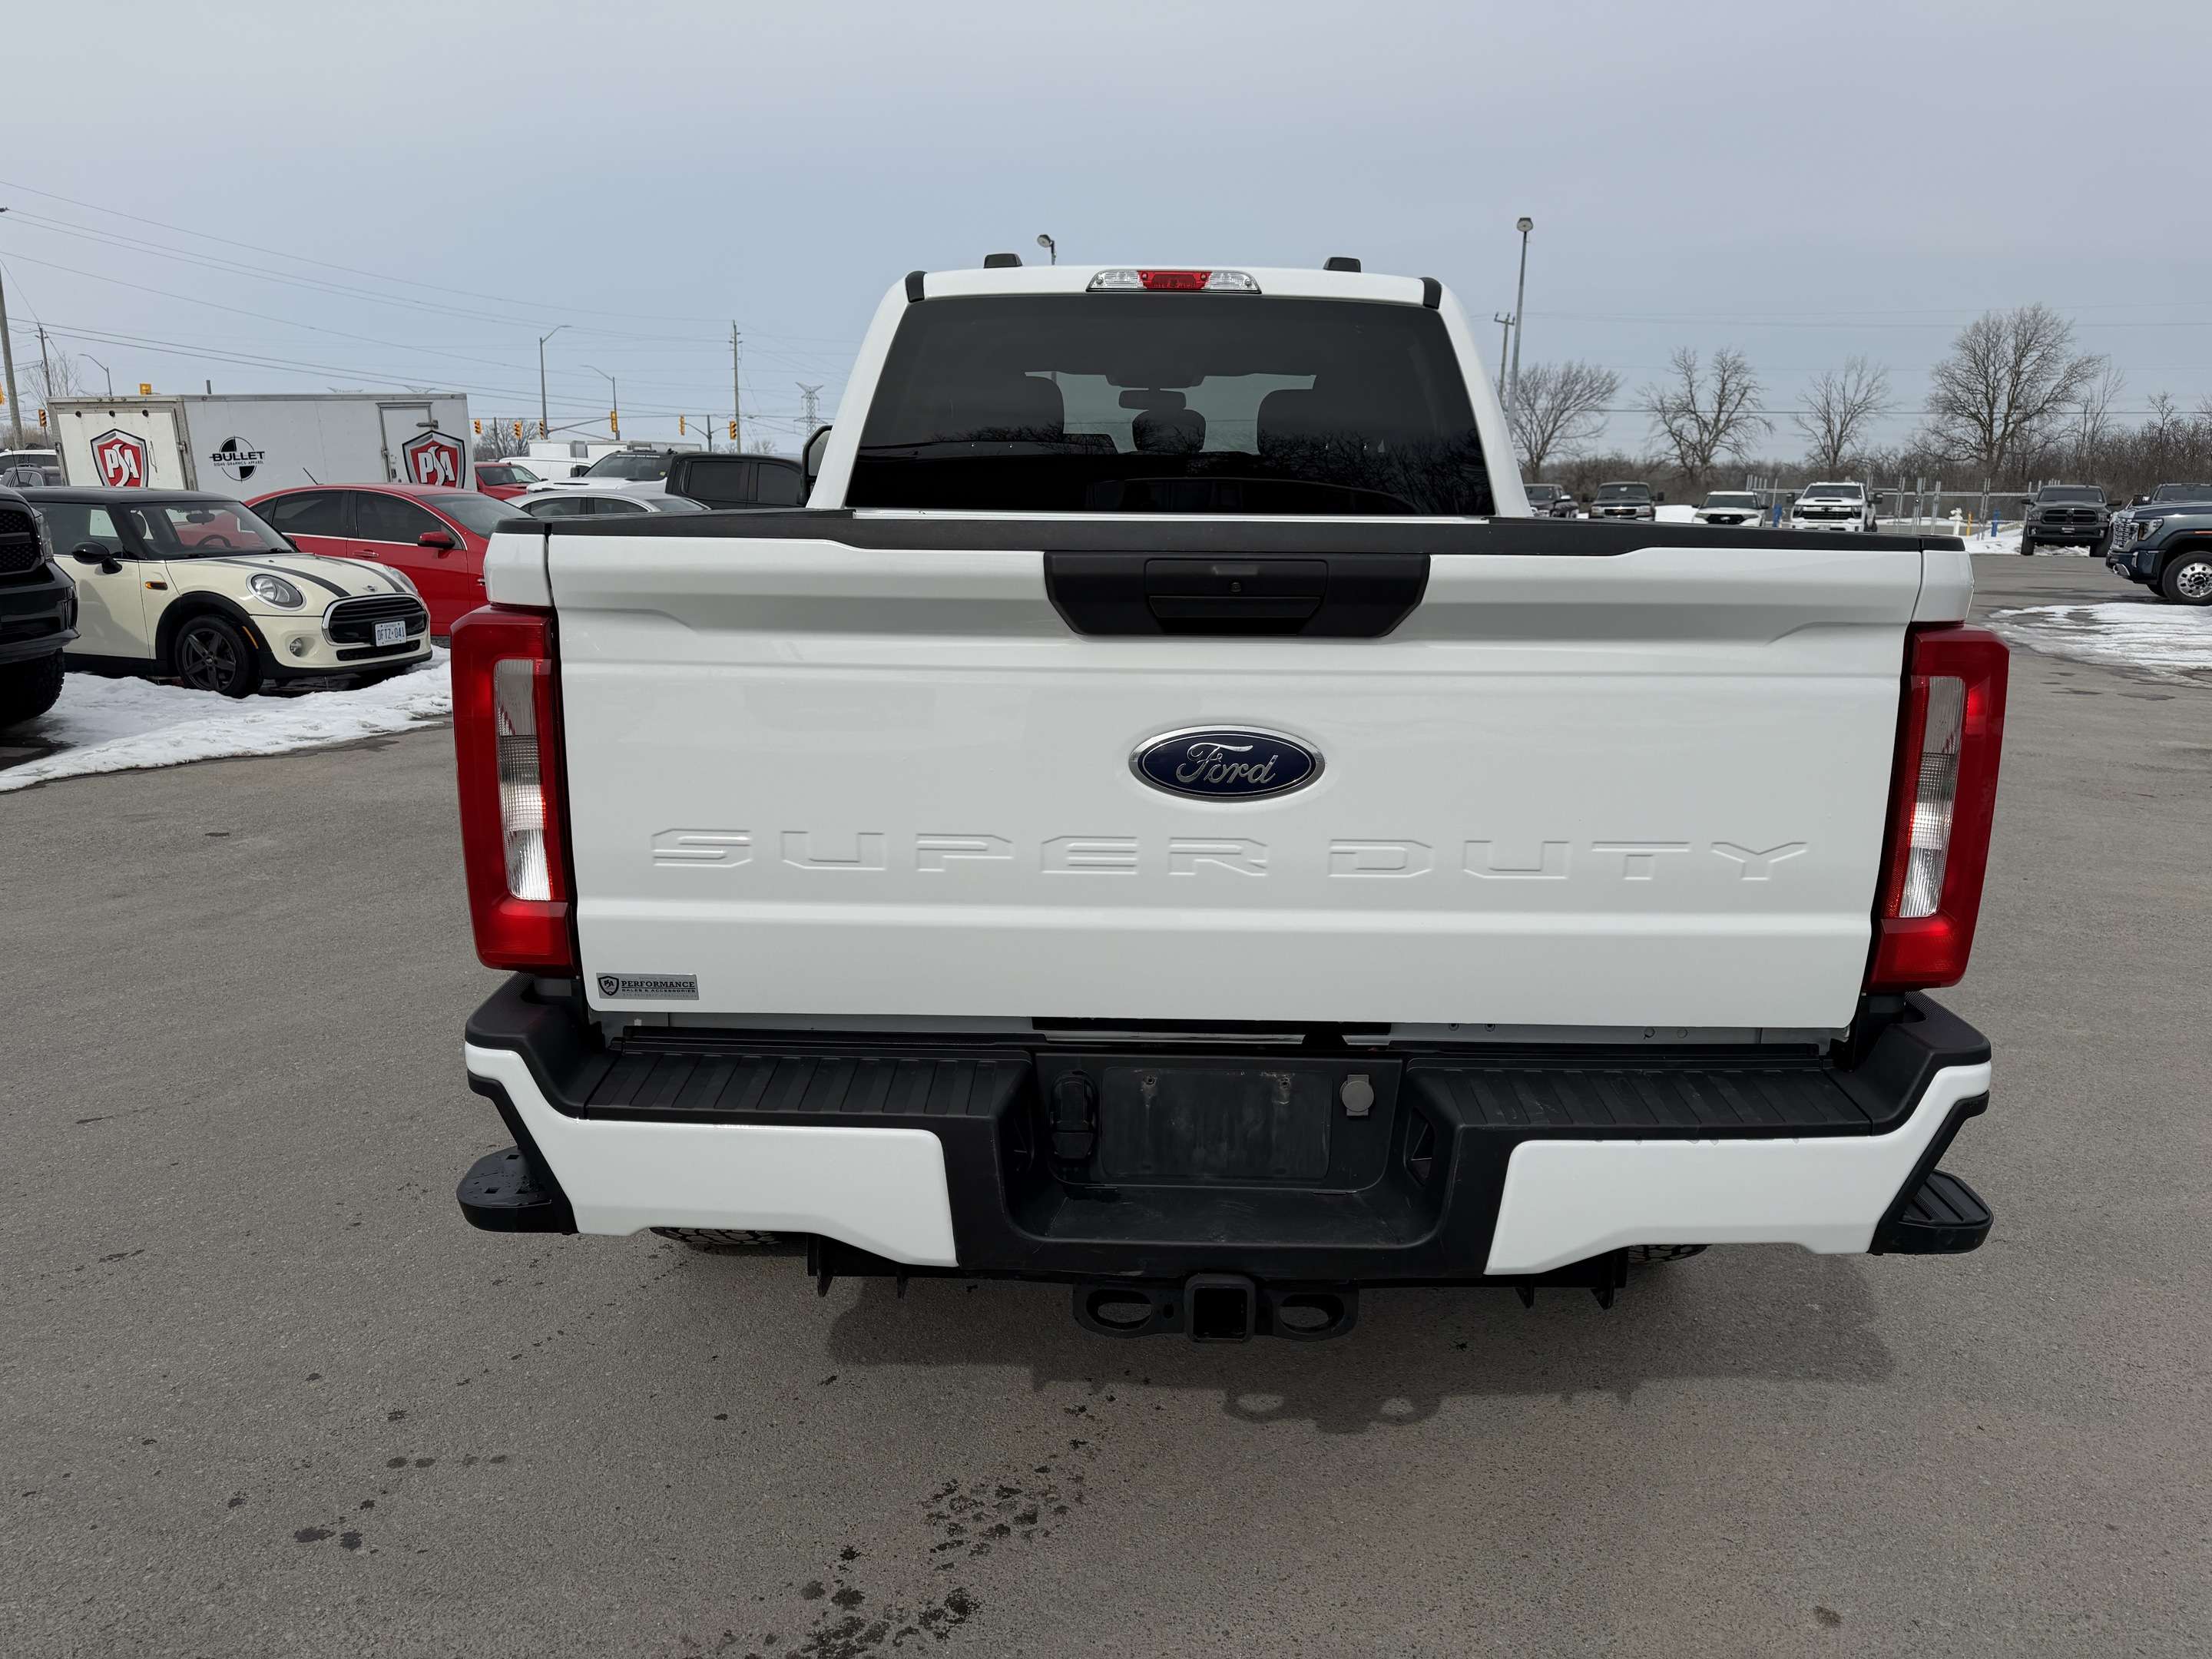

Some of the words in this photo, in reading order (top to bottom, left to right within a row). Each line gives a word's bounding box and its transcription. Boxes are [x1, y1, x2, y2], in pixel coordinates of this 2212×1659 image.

[104, 444, 140, 487] PSA
[212, 451, 265, 462] BULLET
[417, 446, 456, 485] PSA
[1176, 742, 1279, 783] Ford
[651, 828, 1269, 876] SUPER
[1328, 838, 1808, 881] DUTY
